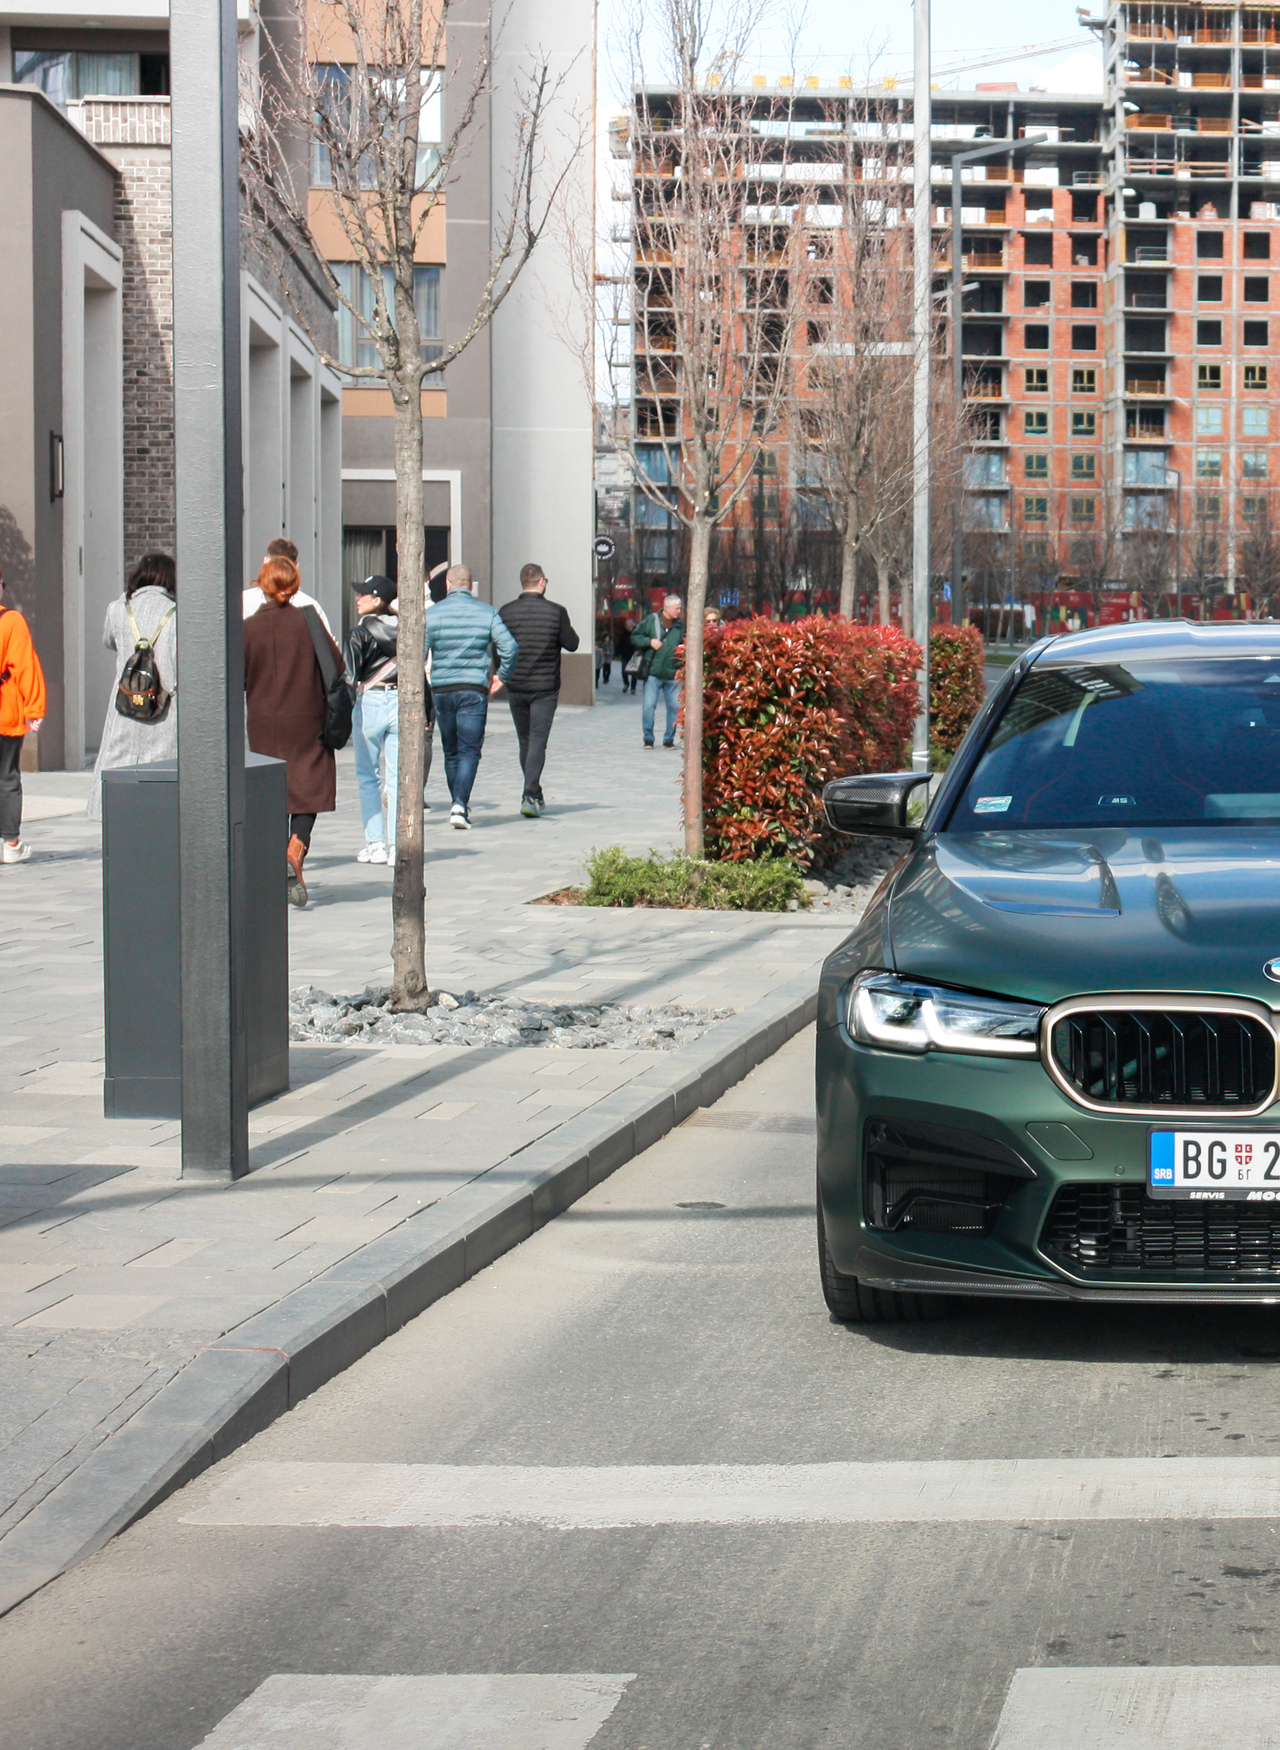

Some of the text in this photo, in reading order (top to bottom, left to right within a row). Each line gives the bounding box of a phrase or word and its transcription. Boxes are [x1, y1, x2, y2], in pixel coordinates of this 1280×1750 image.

[1182, 1140, 1227, 1180] BG
[1153, 1168, 1173, 1180] SRB
[1189, 1191, 1225, 1200] SERVIS
